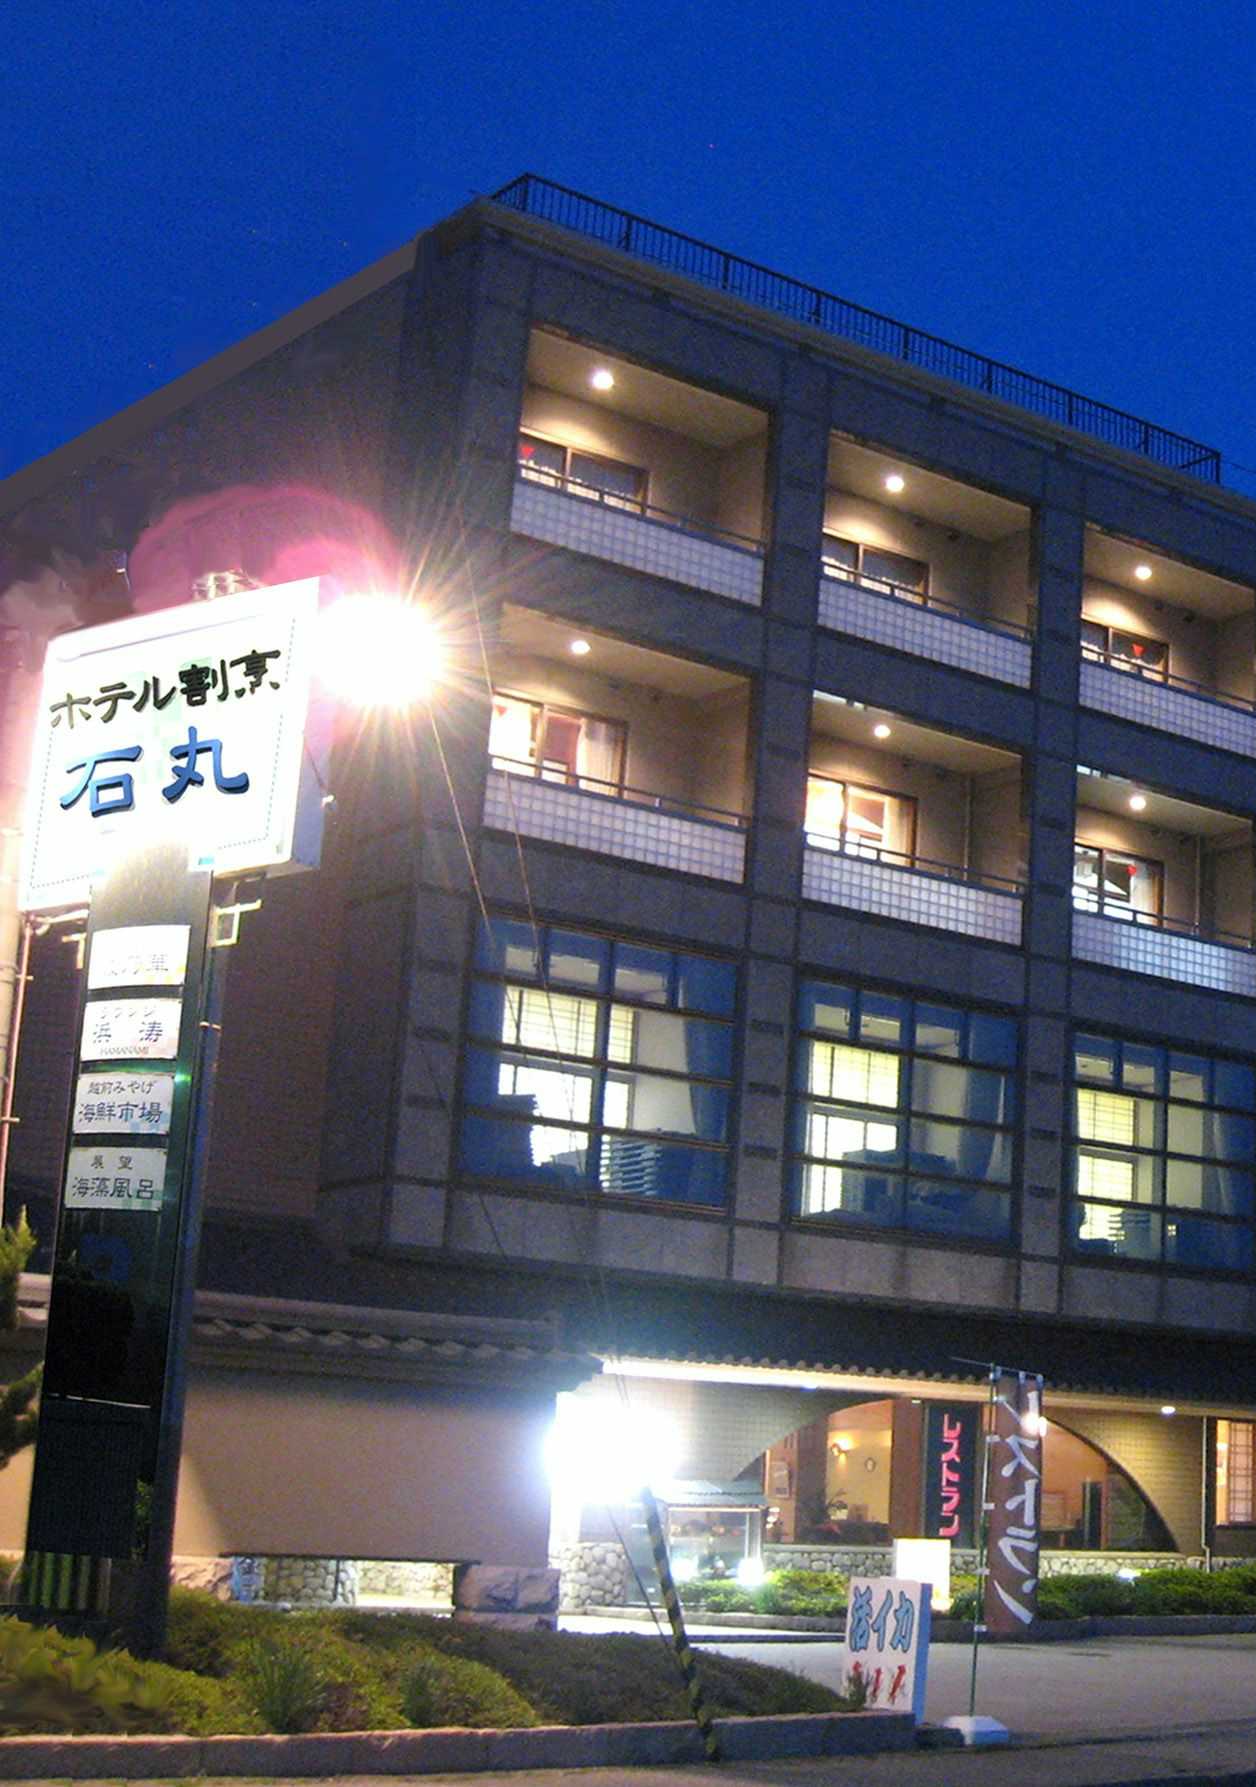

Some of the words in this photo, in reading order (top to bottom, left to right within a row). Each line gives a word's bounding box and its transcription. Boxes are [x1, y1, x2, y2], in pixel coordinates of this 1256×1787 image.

[49, 650, 281, 729] ホテル割烹
[59, 726, 250, 818] 石丸
[79, 1102, 163, 1123] 海鮮市場
[91, 1155, 133, 1170] 展望
[72, 1177, 155, 1200] 海藻風呂
